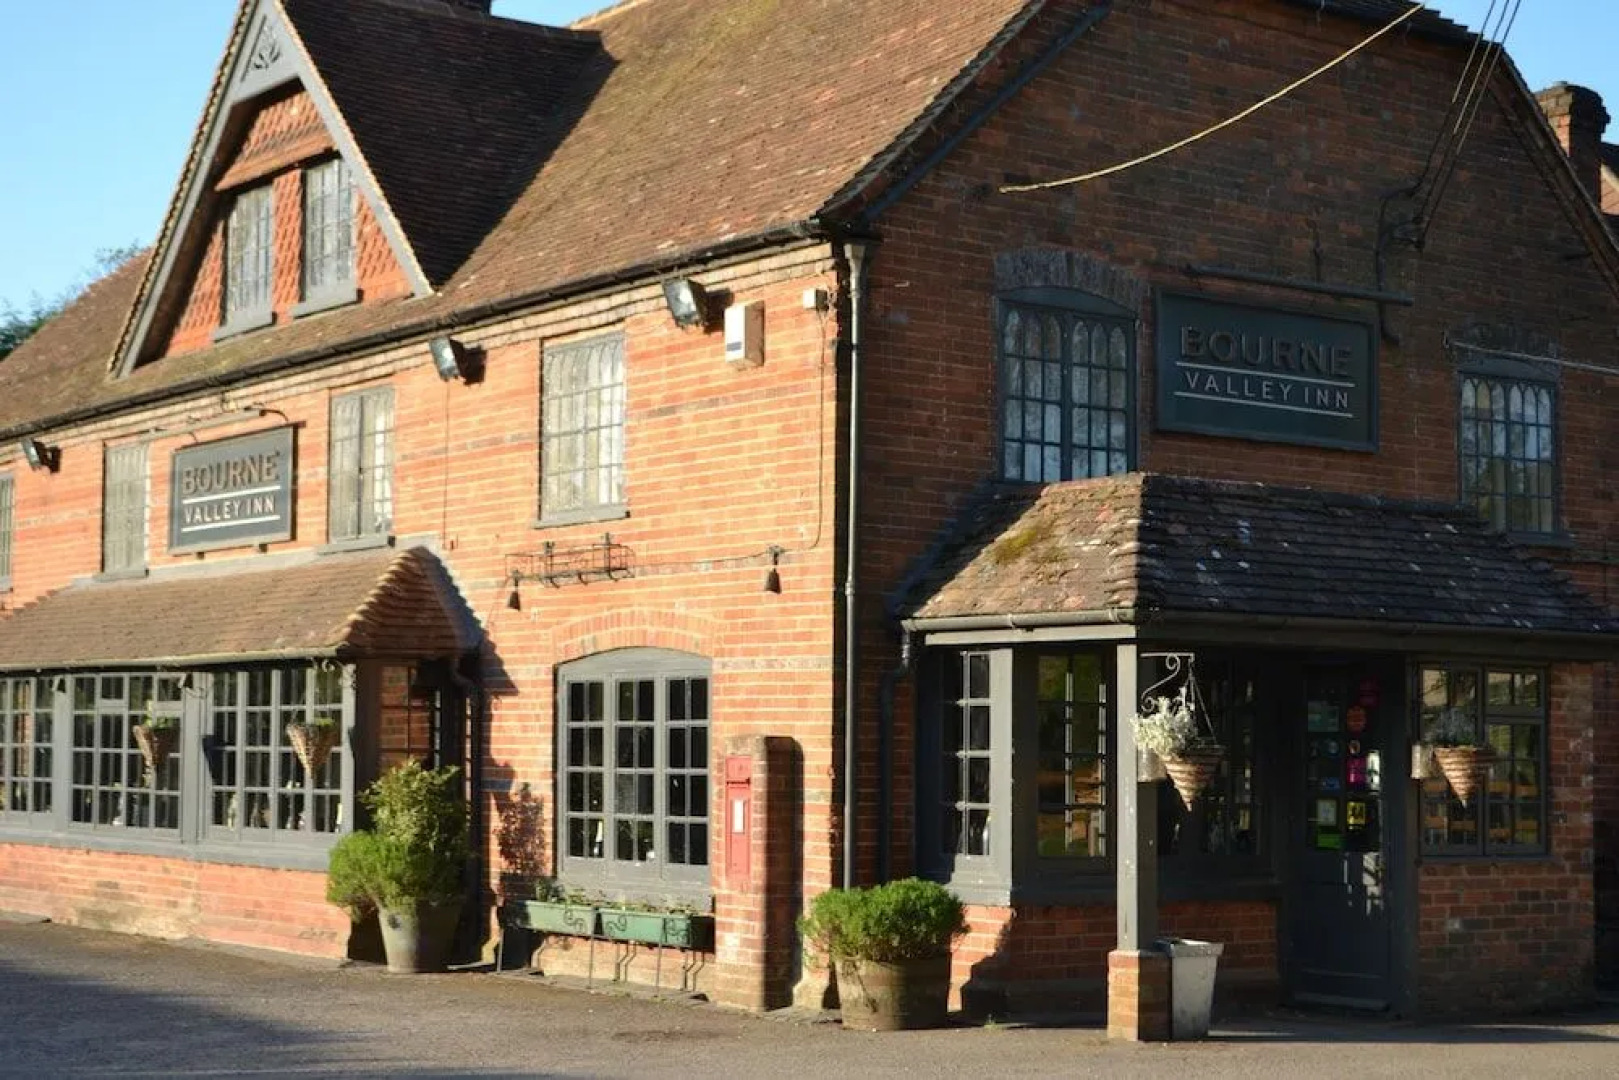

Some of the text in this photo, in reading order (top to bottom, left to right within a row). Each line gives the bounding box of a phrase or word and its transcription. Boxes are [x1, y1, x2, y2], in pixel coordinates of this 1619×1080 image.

[1181, 326, 1351, 375] BOURNE
[1185, 371, 1349, 409] VALLEY INN
[182, 453, 280, 495] BOURNE
[184, 494, 275, 524] VALLEY INN
